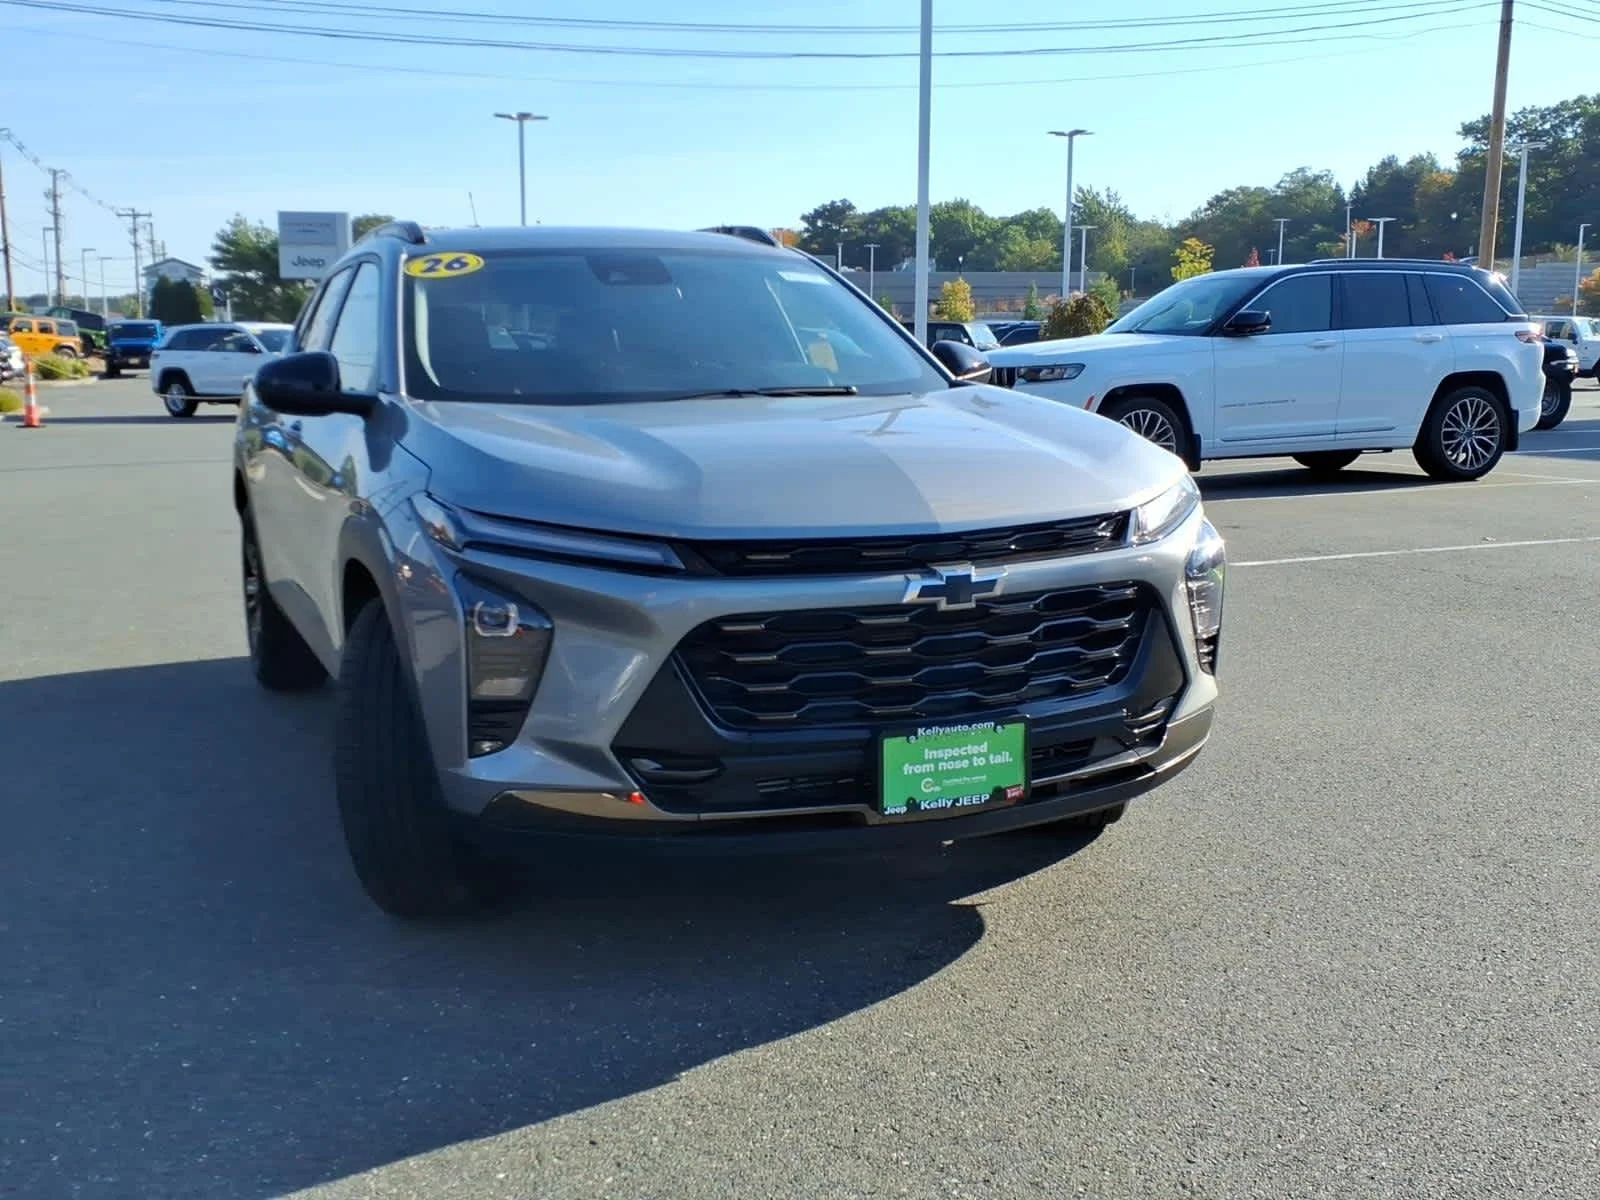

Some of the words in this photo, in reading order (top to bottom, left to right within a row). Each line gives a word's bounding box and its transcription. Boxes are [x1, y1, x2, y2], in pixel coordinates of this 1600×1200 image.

[291, 255, 326, 269] Jeep
[422, 257, 469, 273] 26
[917, 721, 995, 737] Kellyauto.com
[924, 742, 988, 760] Inspected
[903, 763, 934, 775] from
[938, 759, 969, 771] nose
[972, 756, 986, 767] to
[989, 752, 1013, 764] tail.
[921, 798, 954, 810] Kelly
[955, 793, 990, 806] JEEP
[884, 805, 907, 815] Jeep
